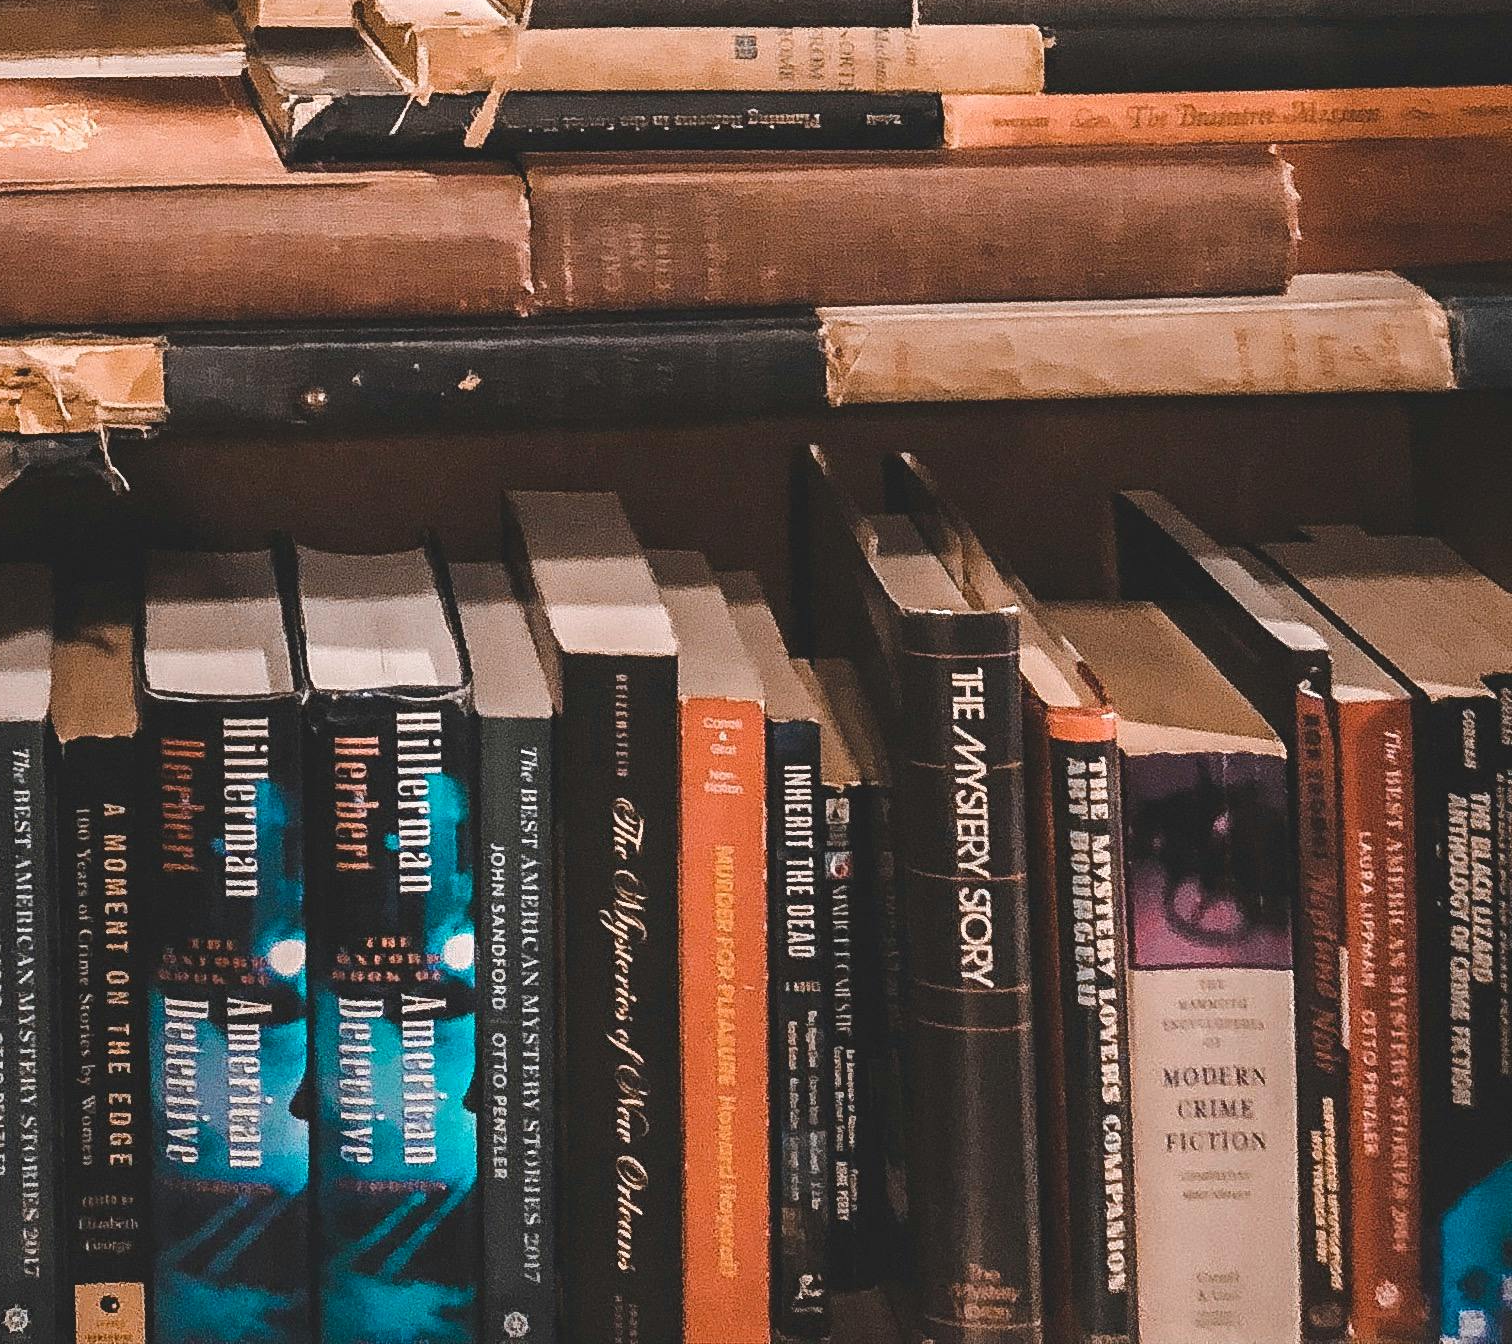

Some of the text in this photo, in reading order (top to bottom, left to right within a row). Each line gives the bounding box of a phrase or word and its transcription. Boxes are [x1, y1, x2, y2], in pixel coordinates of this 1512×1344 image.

[160, 737, 204, 873] Herbert
[221, 718, 271, 898] Hillerman
[333, 736, 381, 872] Herbert
[395, 711, 443, 893] Hillerman
[517, 746, 538, 782] The
[519, 787, 538, 849] BEST
[783, 764, 813, 848] INHERIT
[950, 667, 995, 989] THE MYSTERY STORY
[519, 854, 539, 986] AMERICAN
[784, 857, 813, 897] THE
[786, 904, 815, 959] DEAD
[102, 804, 132, 1168] A MOMENT ON THE EDGE
[520, 994, 540, 1110] MYSTERY
[599, 798, 649, 1272] The Mysteries of New Orleans
[163, 997, 210, 1164] Detective
[227, 997, 272, 1170] American
[338, 998, 386, 1164] Detective
[398, 994, 447, 1165] American
[1161, 1067, 1268, 1088] MODERN
[1161, 1132, 1268, 1153] FICTION
[1176, 1099, 1254, 1120] CRIME
[521, 1118, 541, 1226] STORIES
